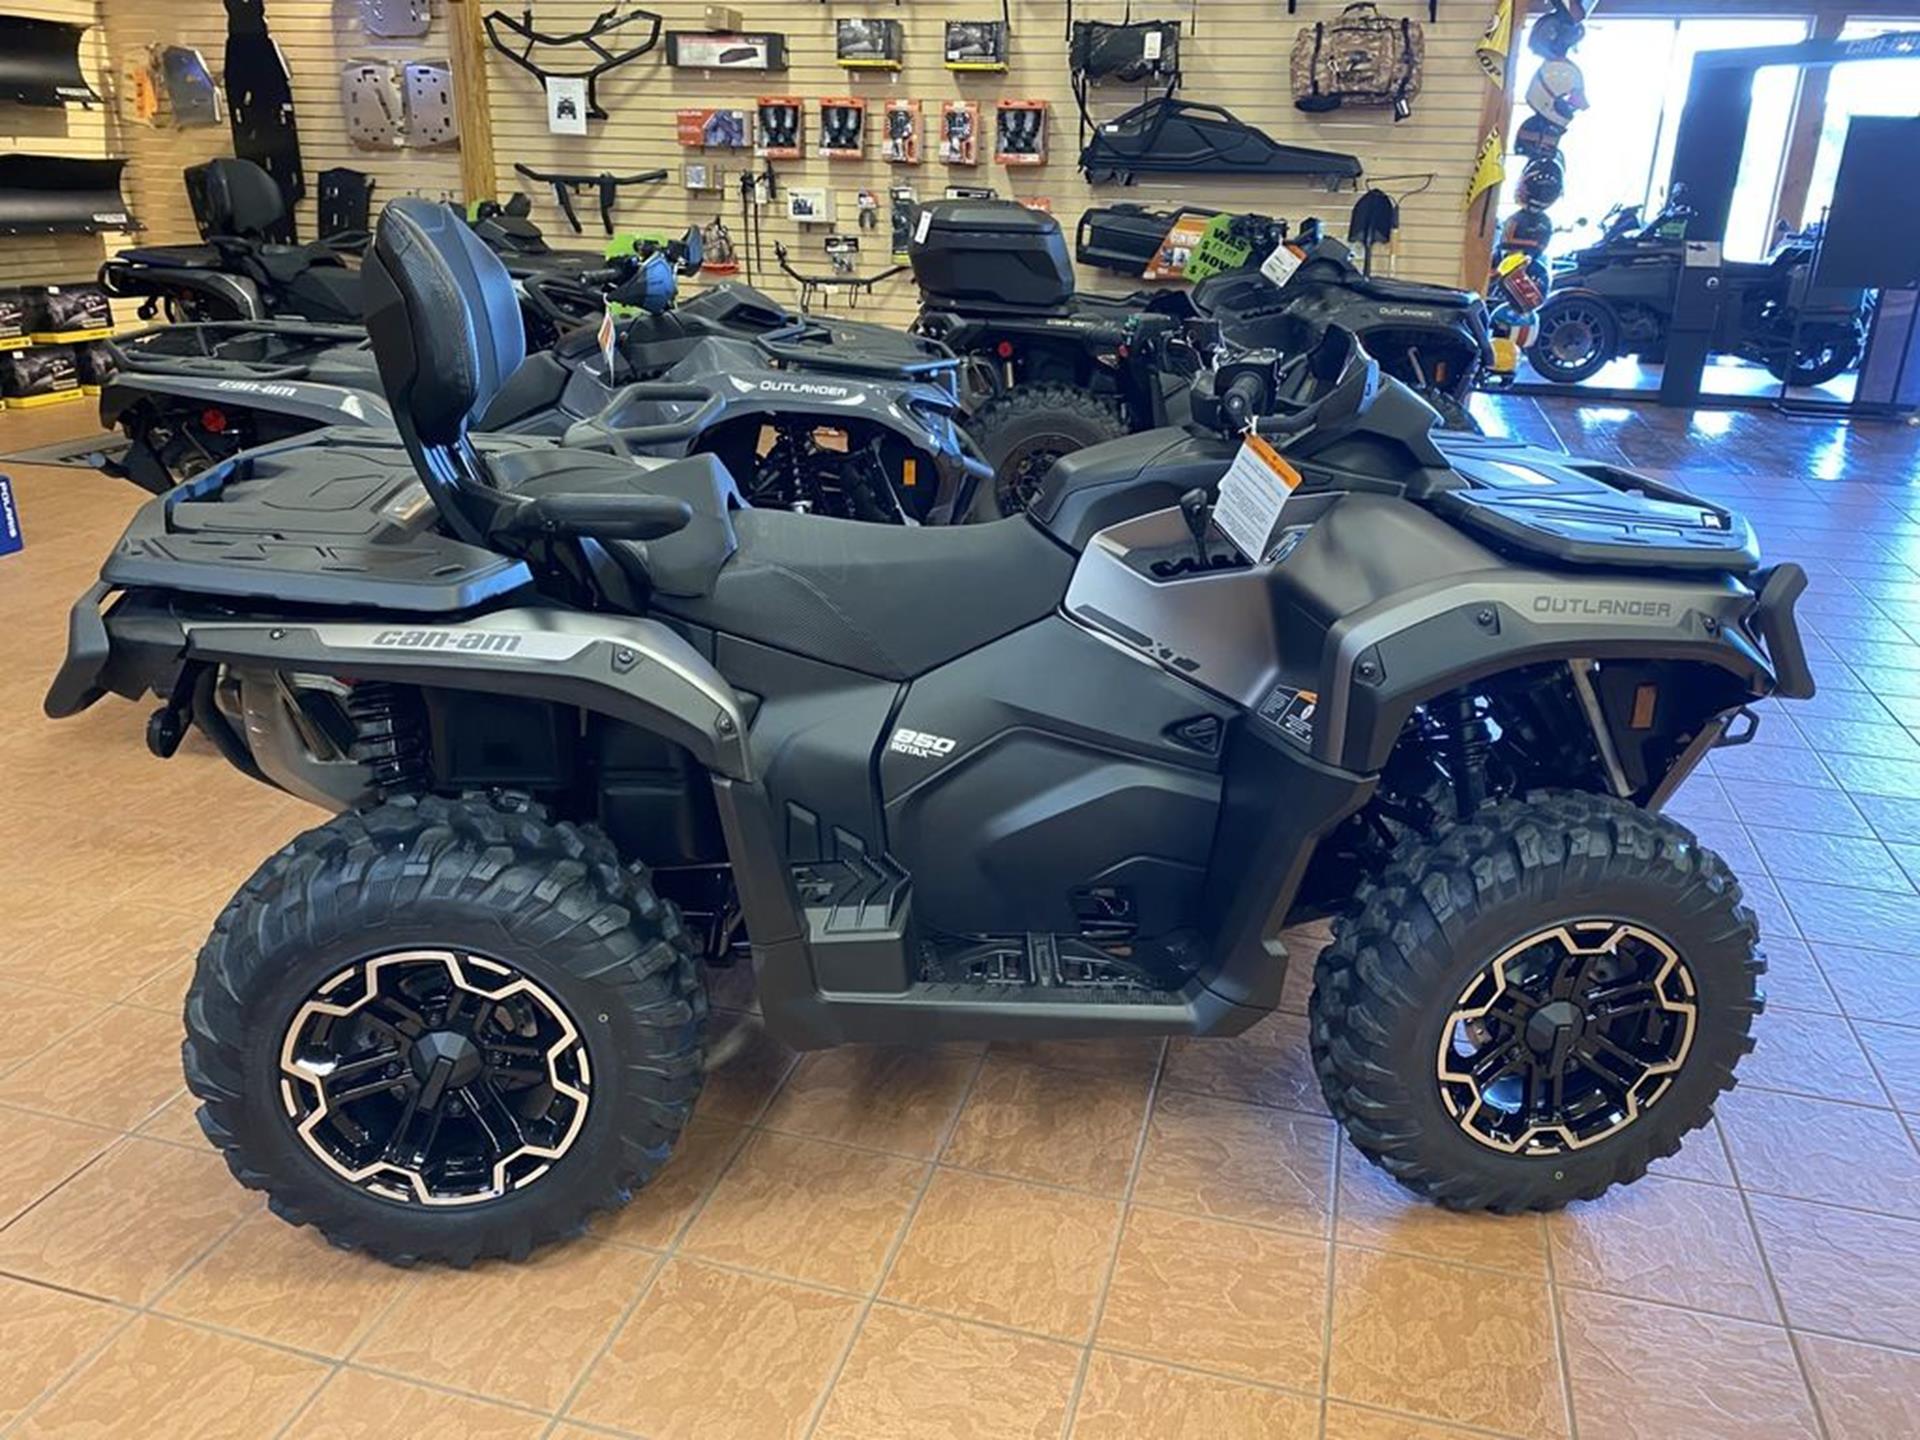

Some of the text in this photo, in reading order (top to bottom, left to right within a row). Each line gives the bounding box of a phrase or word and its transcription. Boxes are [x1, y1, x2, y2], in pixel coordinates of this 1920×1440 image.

[1213, 228, 1247, 251] WAS
[218, 380, 298, 397] can-am
[760, 380, 848, 397] OUTLANDER
[1533, 596, 1671, 617] OUTLANDER
[372, 630, 522, 652] can-am
[890, 741, 928, 758] ROTAX
[893, 728, 957, 753] 850
